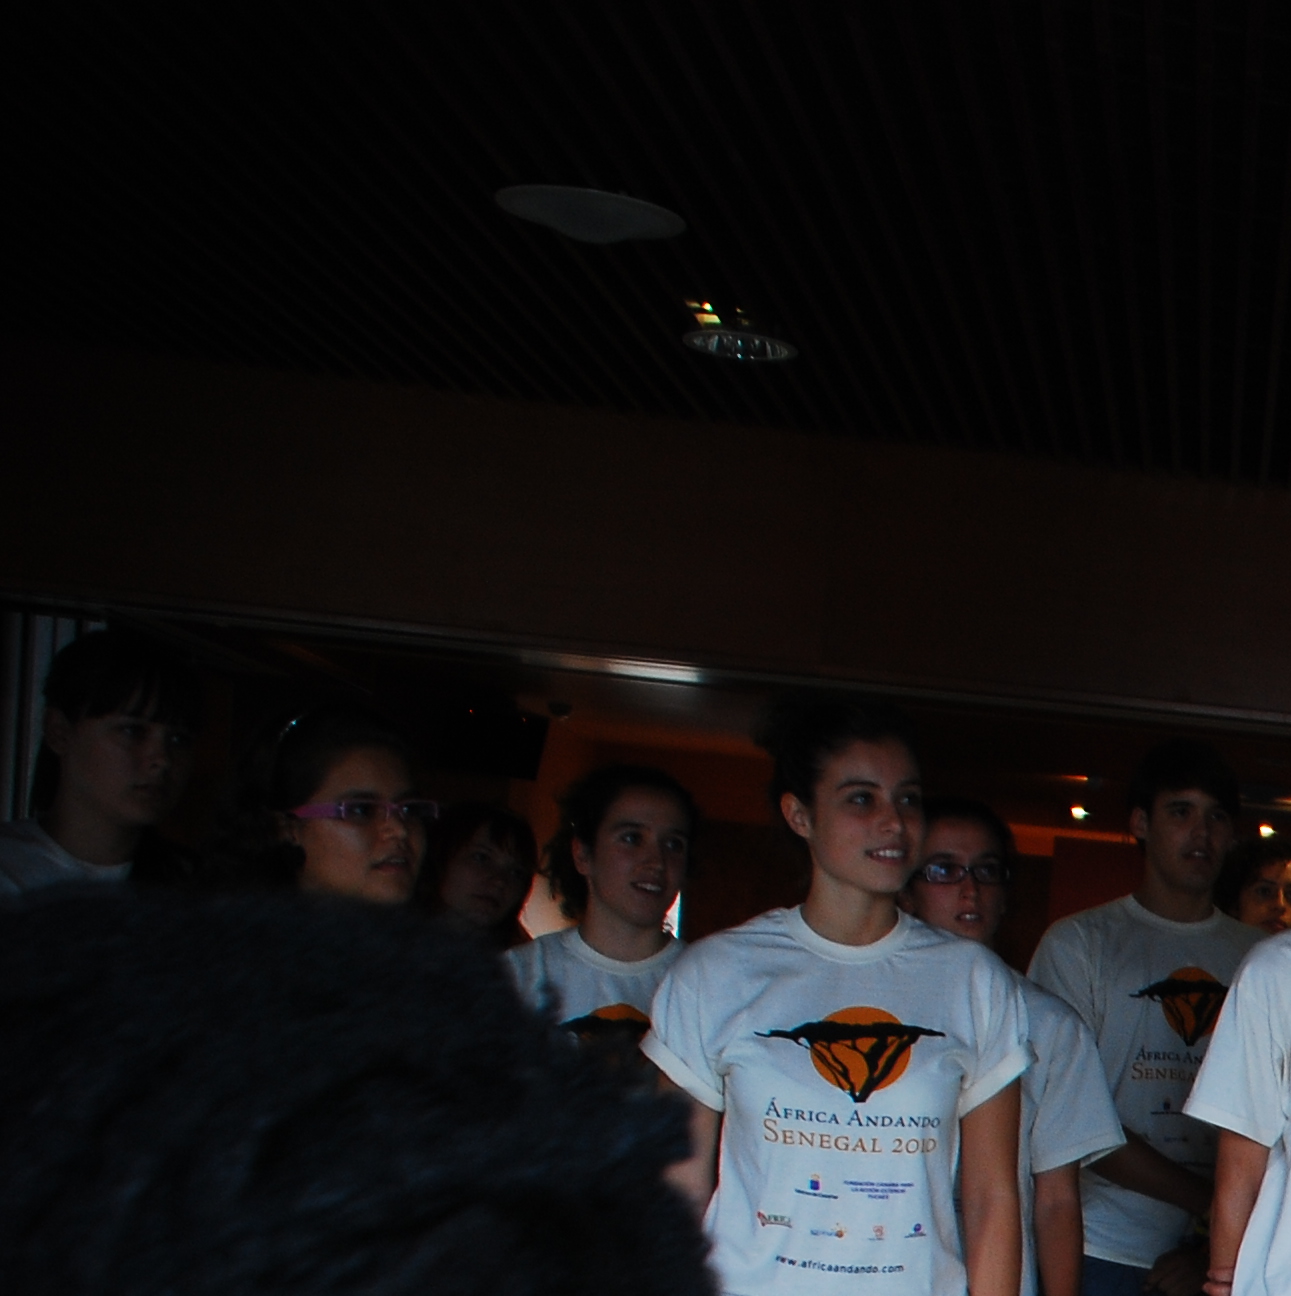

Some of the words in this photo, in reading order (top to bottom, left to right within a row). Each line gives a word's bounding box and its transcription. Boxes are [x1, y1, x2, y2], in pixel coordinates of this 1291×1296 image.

[1131, 1062, 1195, 1082] SENEGA
[765, 1097, 840, 1125] ÁFRICA
[847, 1109, 941, 1128] ANDANDO
[763, 1118, 883, 1153] SENEGAL
